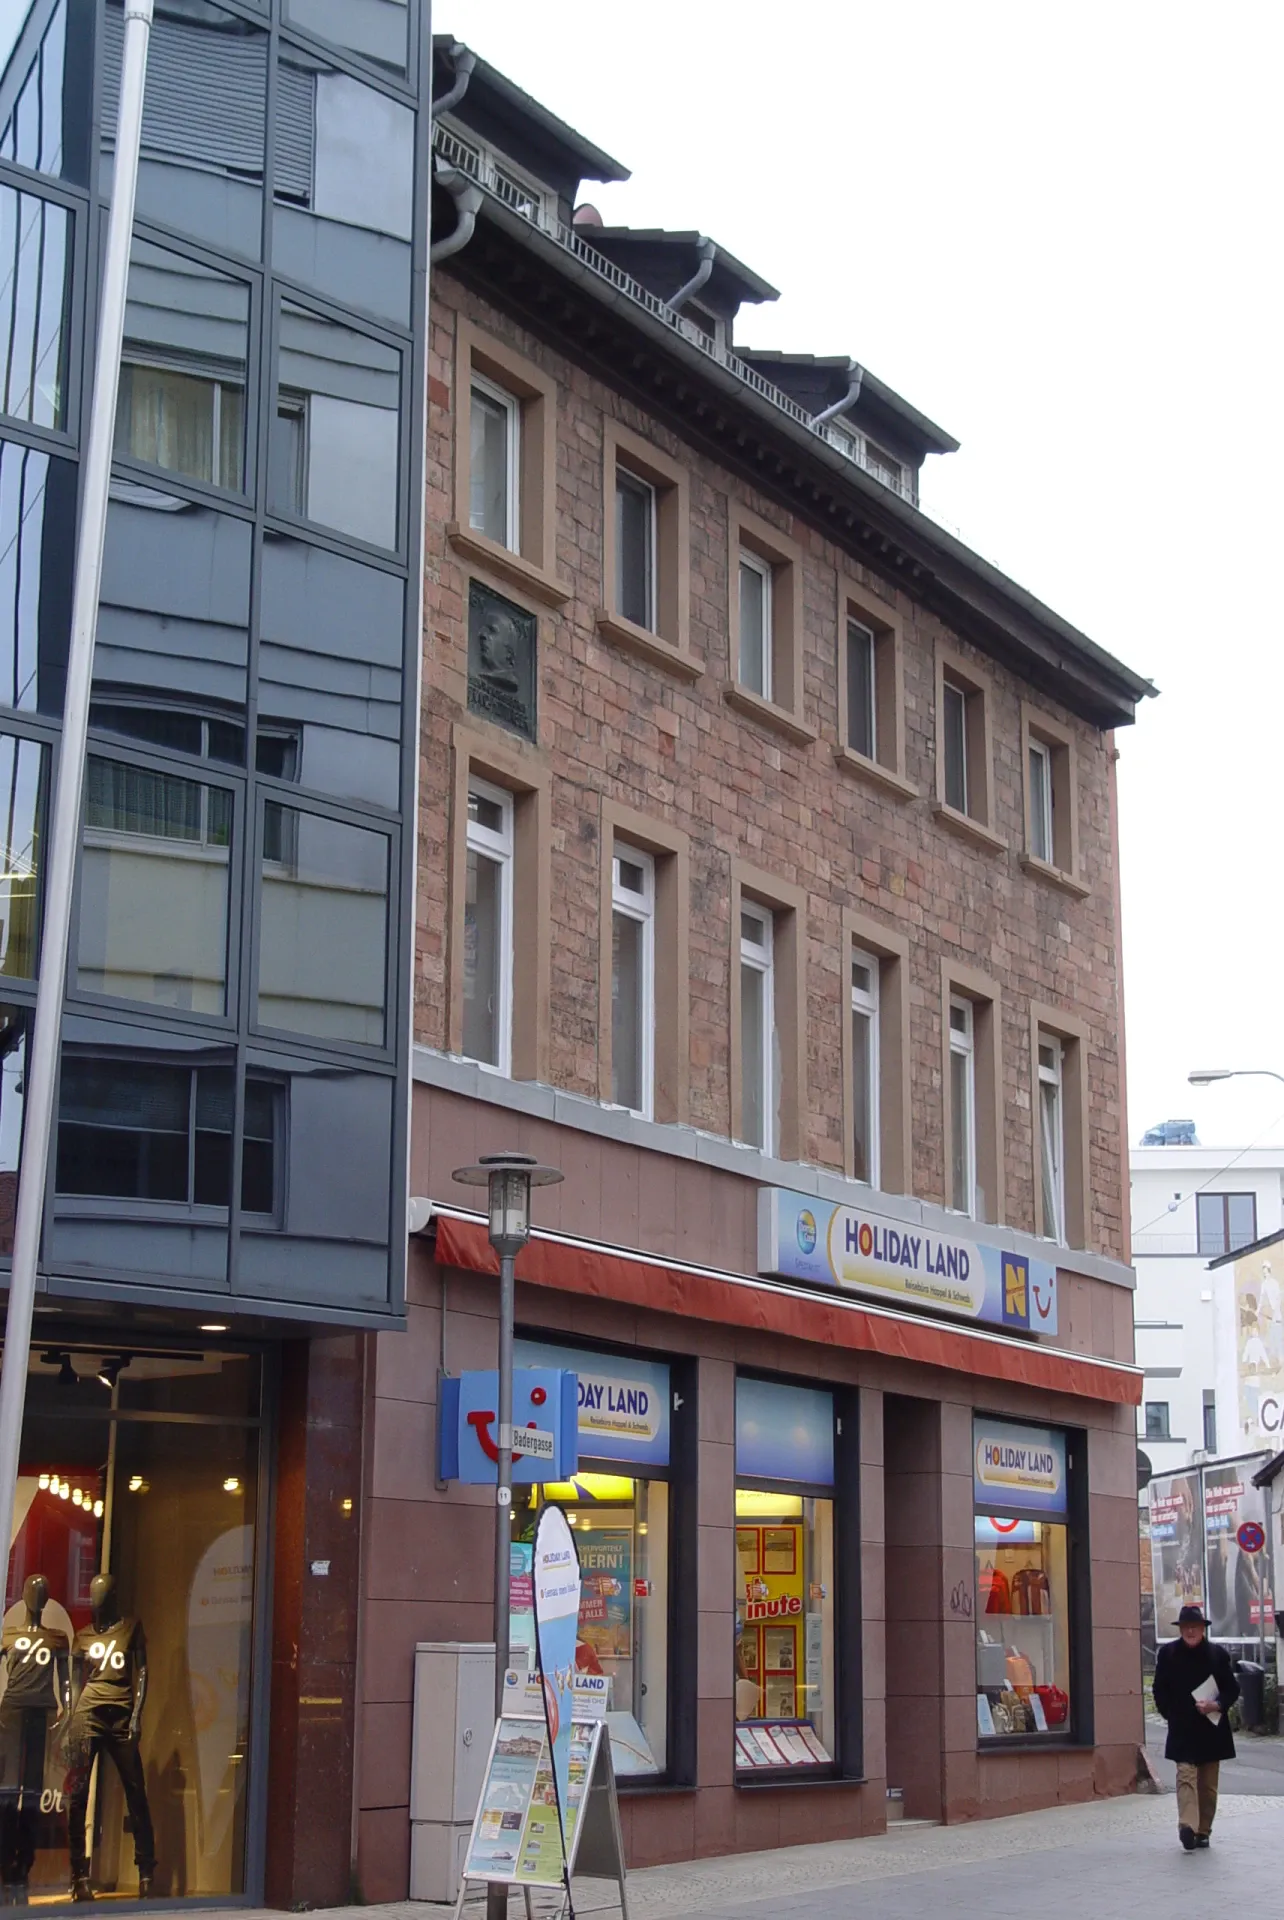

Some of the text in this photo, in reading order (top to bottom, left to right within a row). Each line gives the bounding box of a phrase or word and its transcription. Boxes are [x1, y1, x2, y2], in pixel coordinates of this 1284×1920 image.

[845, 1216, 970, 1282] HOLIDAY LAND
[608, 1385, 649, 1416] LAND
[513, 1429, 553, 1454] Badergasse
[985, 1444, 1053, 1474] HOLIDAY LAND
[747, 1594, 802, 1620] inute
[575, 1677, 604, 1690] LAND
